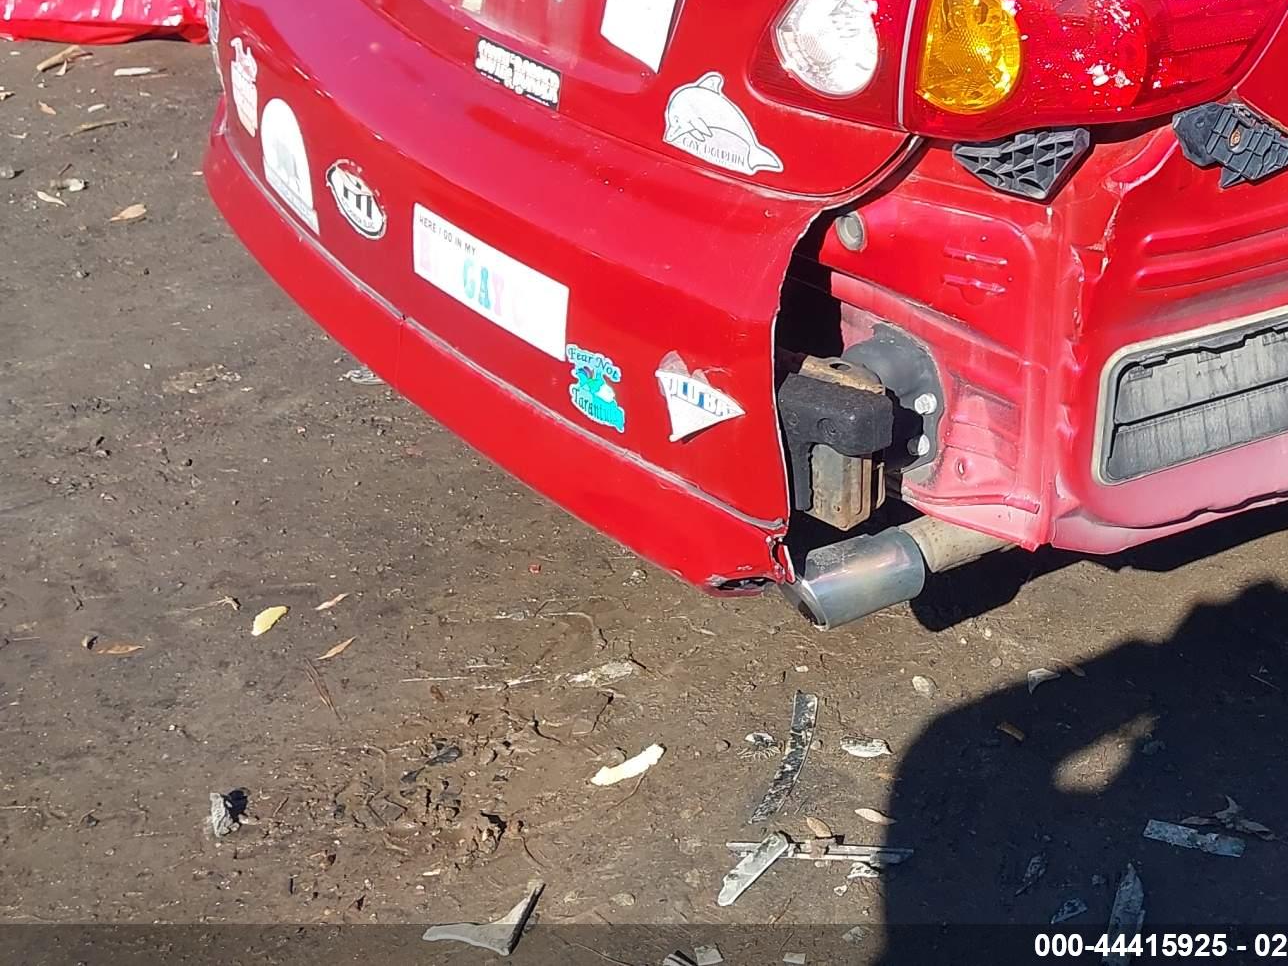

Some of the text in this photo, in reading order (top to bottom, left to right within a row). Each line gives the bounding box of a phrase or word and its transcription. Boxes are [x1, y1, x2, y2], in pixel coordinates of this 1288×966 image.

[419, 214, 437, 234] HERE
[464, 242, 477, 256] MY
[463, 258, 505, 317] GAY
[567, 347, 620, 381] Fear Not
